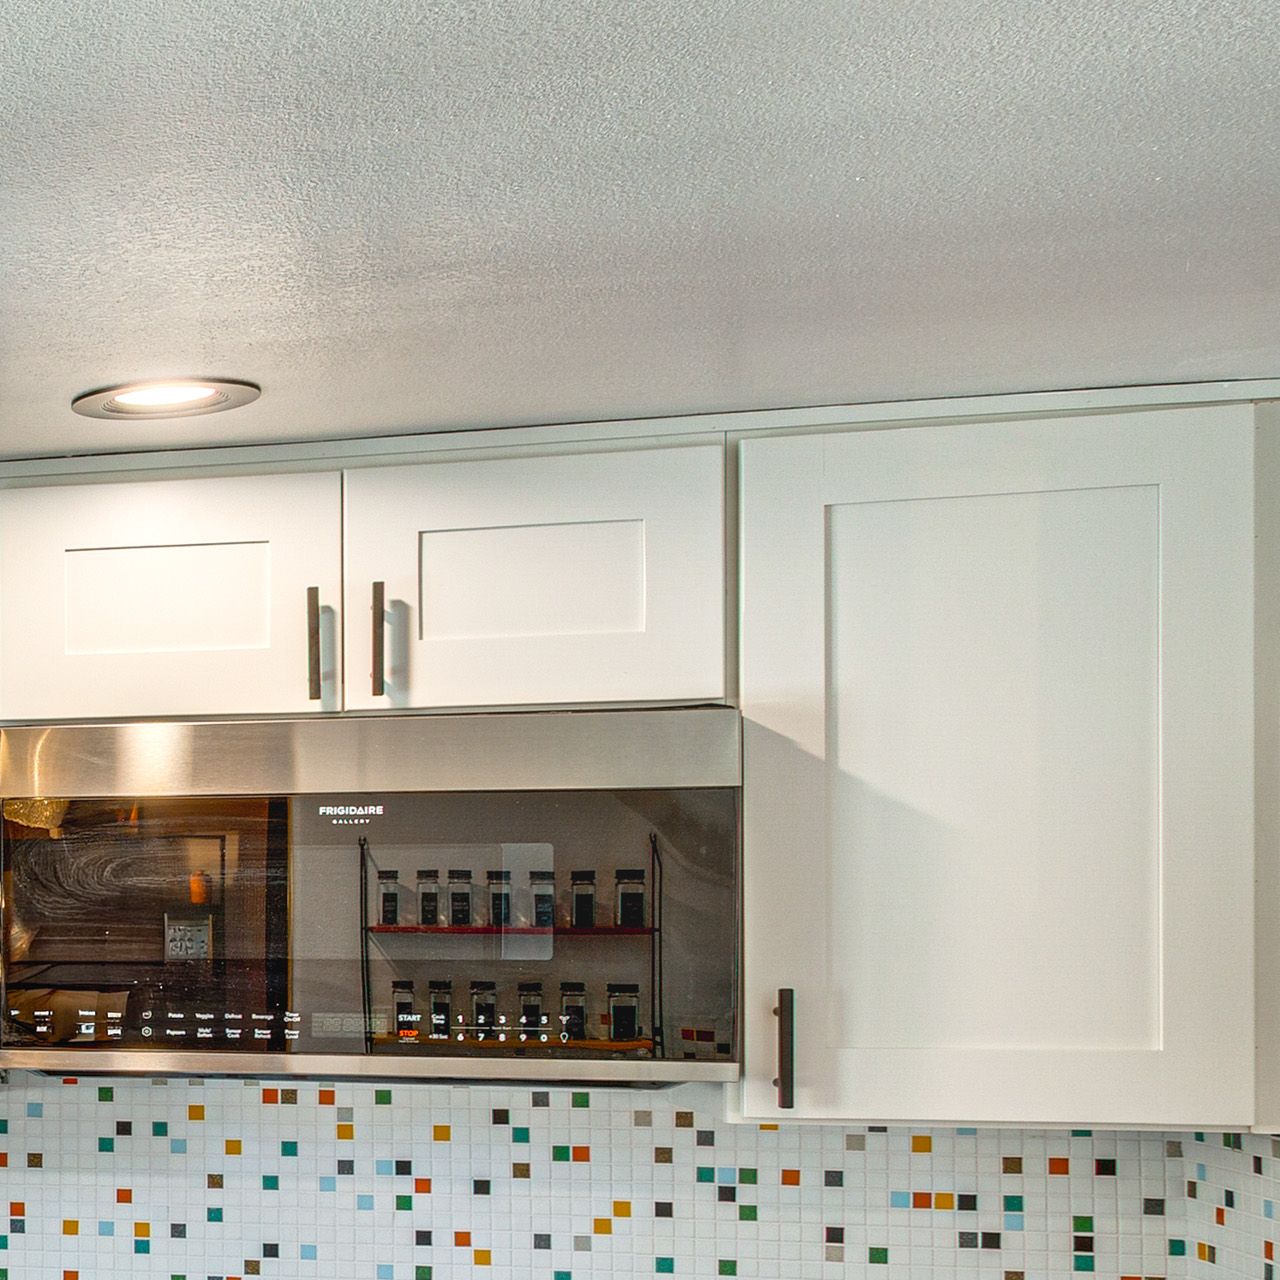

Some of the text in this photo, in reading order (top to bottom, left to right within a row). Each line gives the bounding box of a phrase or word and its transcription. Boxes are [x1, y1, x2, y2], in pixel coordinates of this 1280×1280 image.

[319, 806, 384, 816] FRIGIDAIRE
[398, 1014, 422, 1022] START
[457, 1015, 548, 1024] 1 2 3 4 5
[457, 1033, 548, 1042] 6 7 8 9 0
